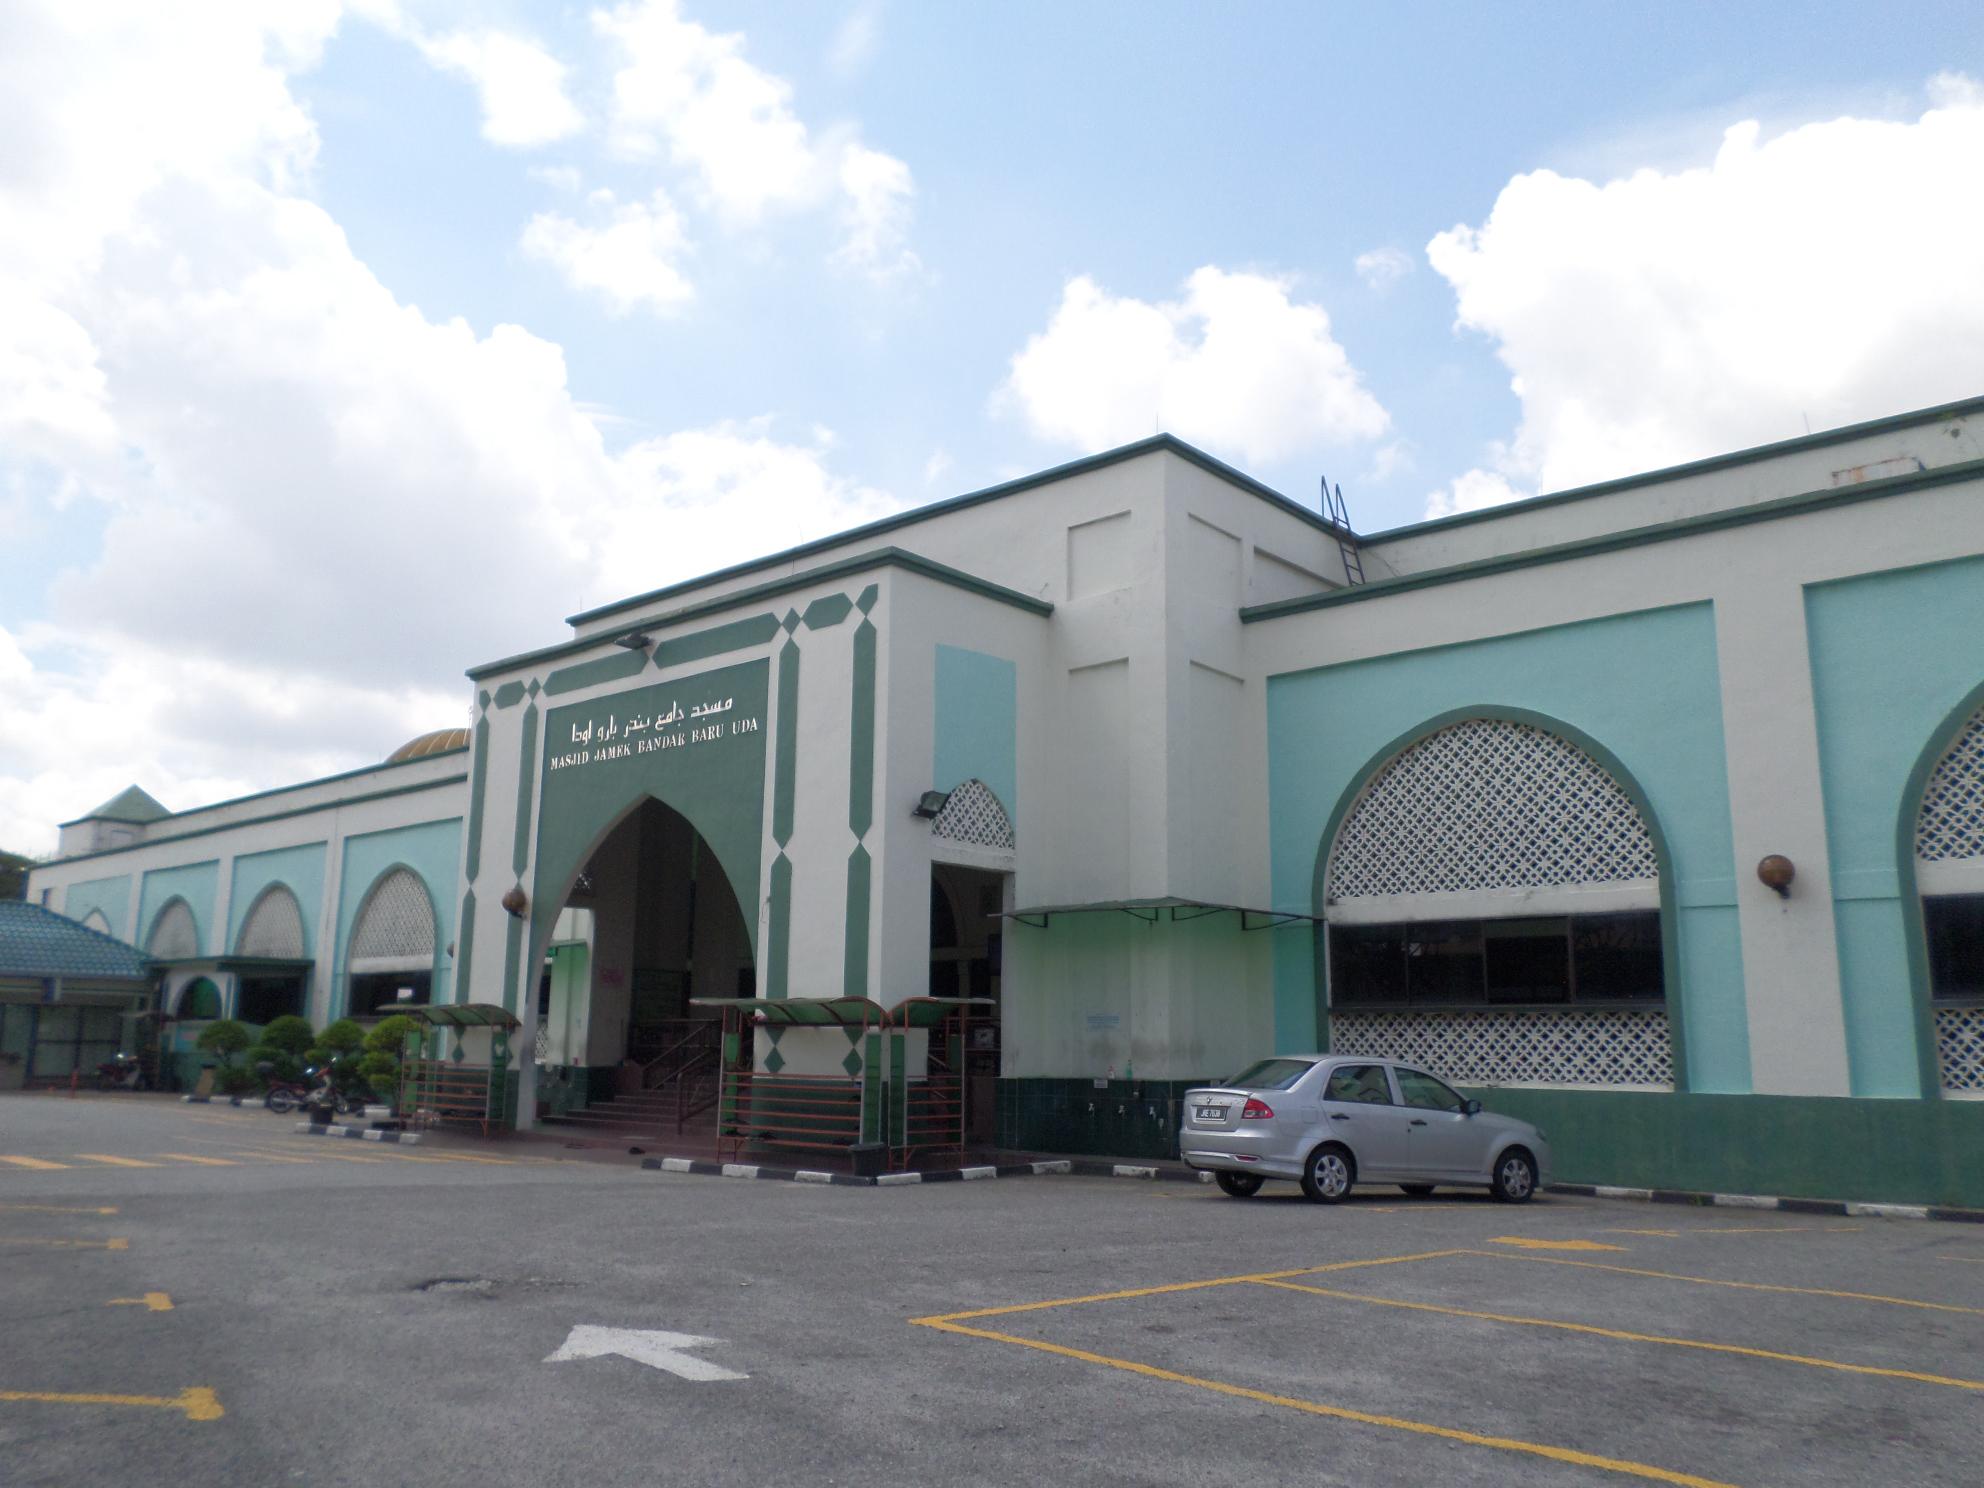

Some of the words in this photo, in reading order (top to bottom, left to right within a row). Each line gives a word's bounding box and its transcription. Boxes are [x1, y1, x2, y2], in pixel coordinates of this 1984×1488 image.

[655, 700, 685, 731] جامع
[690, 697, 733, 721] مسجد
[571, 719, 592, 746] اودا
[597, 714, 617, 742] بارو
[623, 714, 650, 738] بندر
[550, 751, 589, 770] MASJID
[594, 743, 631, 761] JAMEK
[638, 733, 686, 754] BANDAR
[691, 723, 724, 743] BARU
[732, 717, 758, 735] UDA
